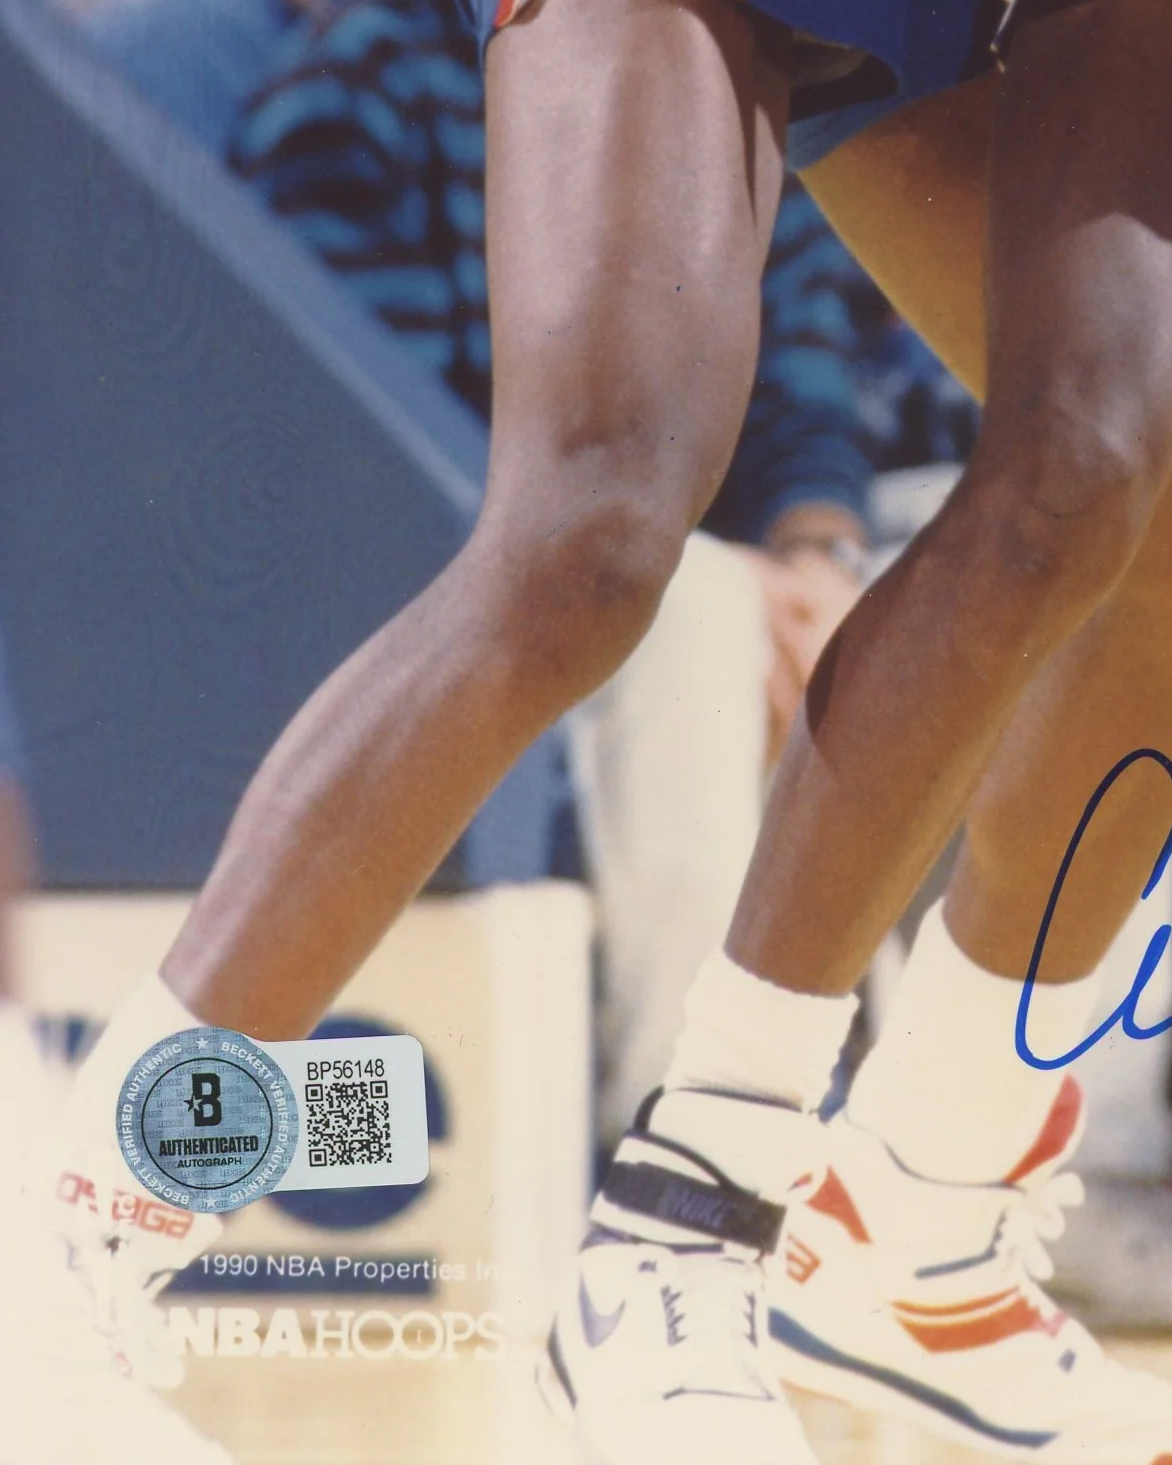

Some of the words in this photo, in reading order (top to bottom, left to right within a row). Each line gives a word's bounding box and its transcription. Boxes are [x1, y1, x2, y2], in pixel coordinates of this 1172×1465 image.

[127, 1042, 182, 1101] AUTHENTIC
[221, 1041, 273, 1078] BECKETT
[306, 1058, 385, 1080] BP56148
[270, 1081, 289, 1142] VERIFIED
[122, 1103, 140, 1164] VERIFIED
[159, 1135, 259, 1156] AUTHENTICATED
[177, 1156, 242, 1168] AUTOGRAPH
[229, 1146, 284, 1203] AUTHENTIC
[137, 1165, 190, 1205] BECKETT
